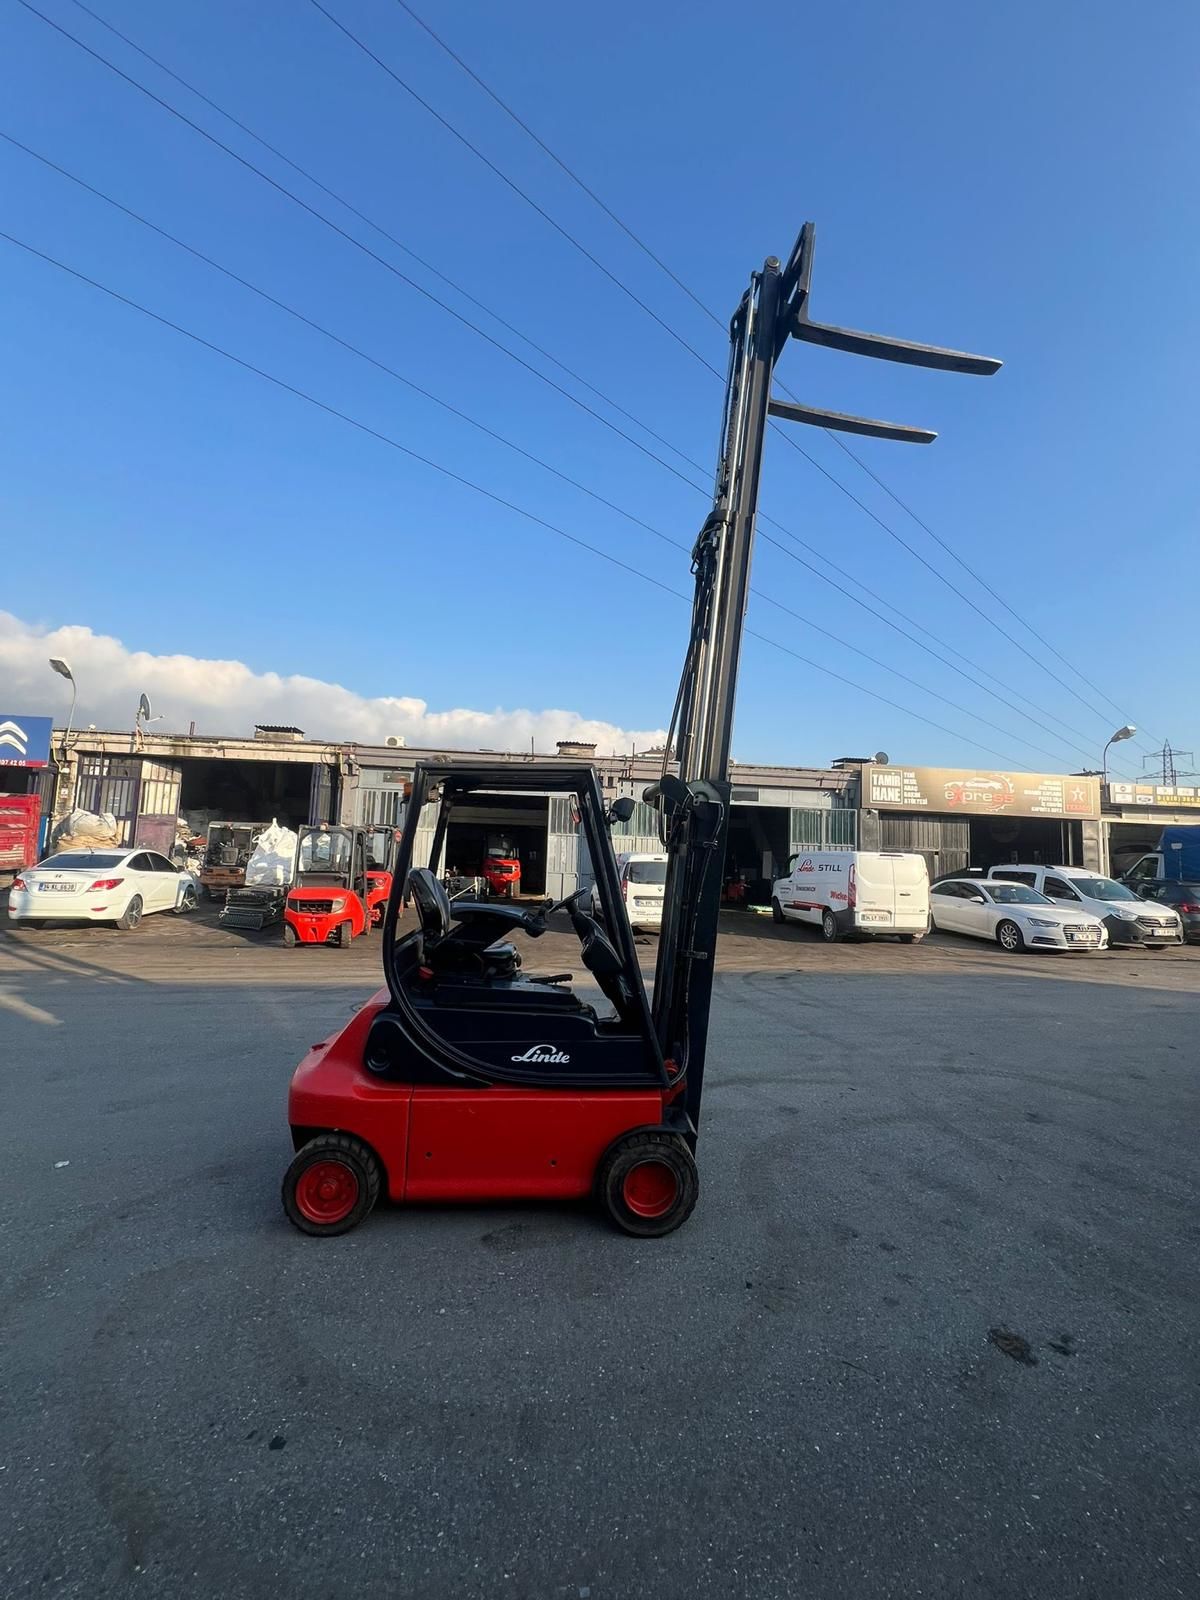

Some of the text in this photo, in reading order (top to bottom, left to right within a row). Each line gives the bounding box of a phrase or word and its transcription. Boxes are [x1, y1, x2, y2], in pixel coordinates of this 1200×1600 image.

[872, 786, 901, 802] HANE
[818, 864, 842, 872] STILL
[511, 1044, 570, 1063] Linde
